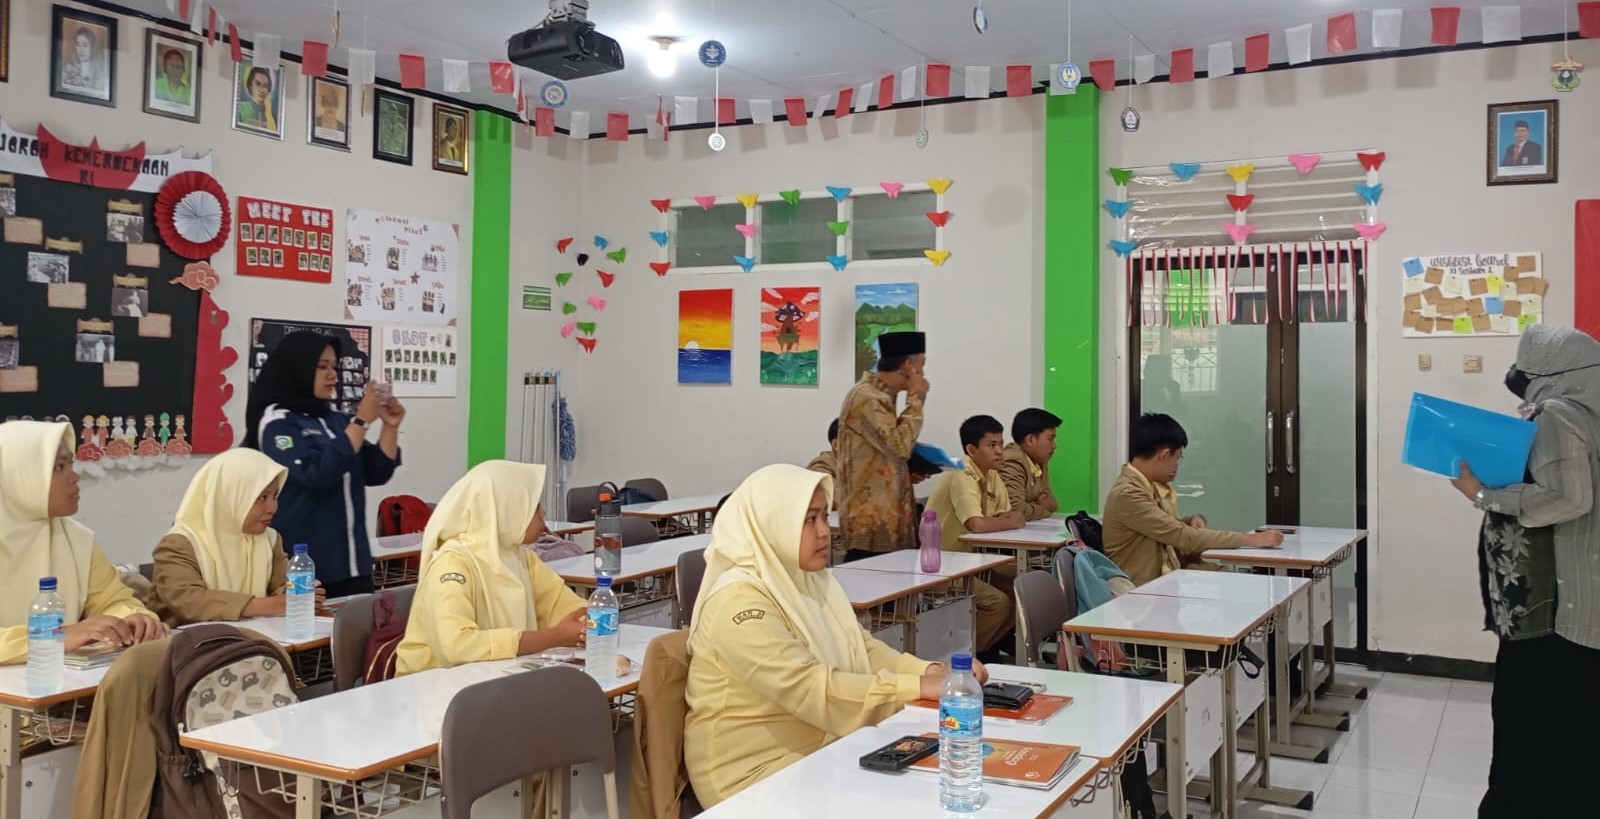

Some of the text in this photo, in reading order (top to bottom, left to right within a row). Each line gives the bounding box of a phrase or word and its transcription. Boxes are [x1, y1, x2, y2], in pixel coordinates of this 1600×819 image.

[64, 144, 169, 177] KEMERDEKAAN
[80, 169, 95, 186] RI
[246, 202, 330, 228] MEET THE
